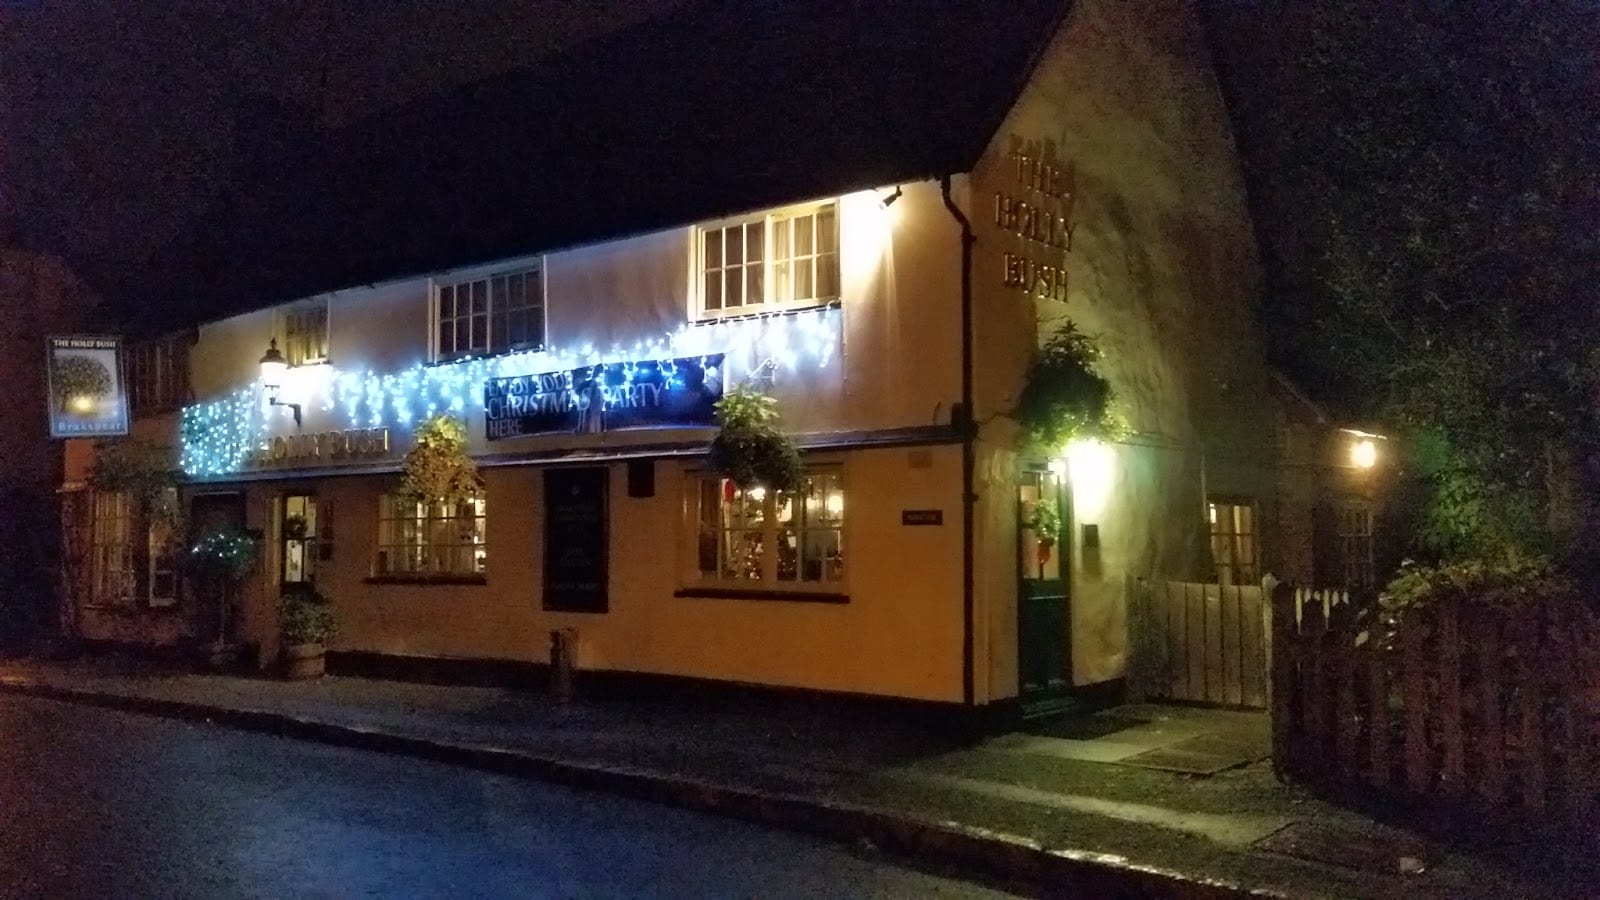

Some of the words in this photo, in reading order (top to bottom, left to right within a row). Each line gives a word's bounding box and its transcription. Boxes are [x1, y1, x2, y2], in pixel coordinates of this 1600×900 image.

[1013, 154, 1061, 199] THE
[994, 192, 1076, 252] HOLLY
[1004, 252, 1067, 303] BUSH
[488, 386, 592, 420] CHRISTMAS
[601, 382, 664, 409] PARTY
[489, 418, 522, 437] HERE
